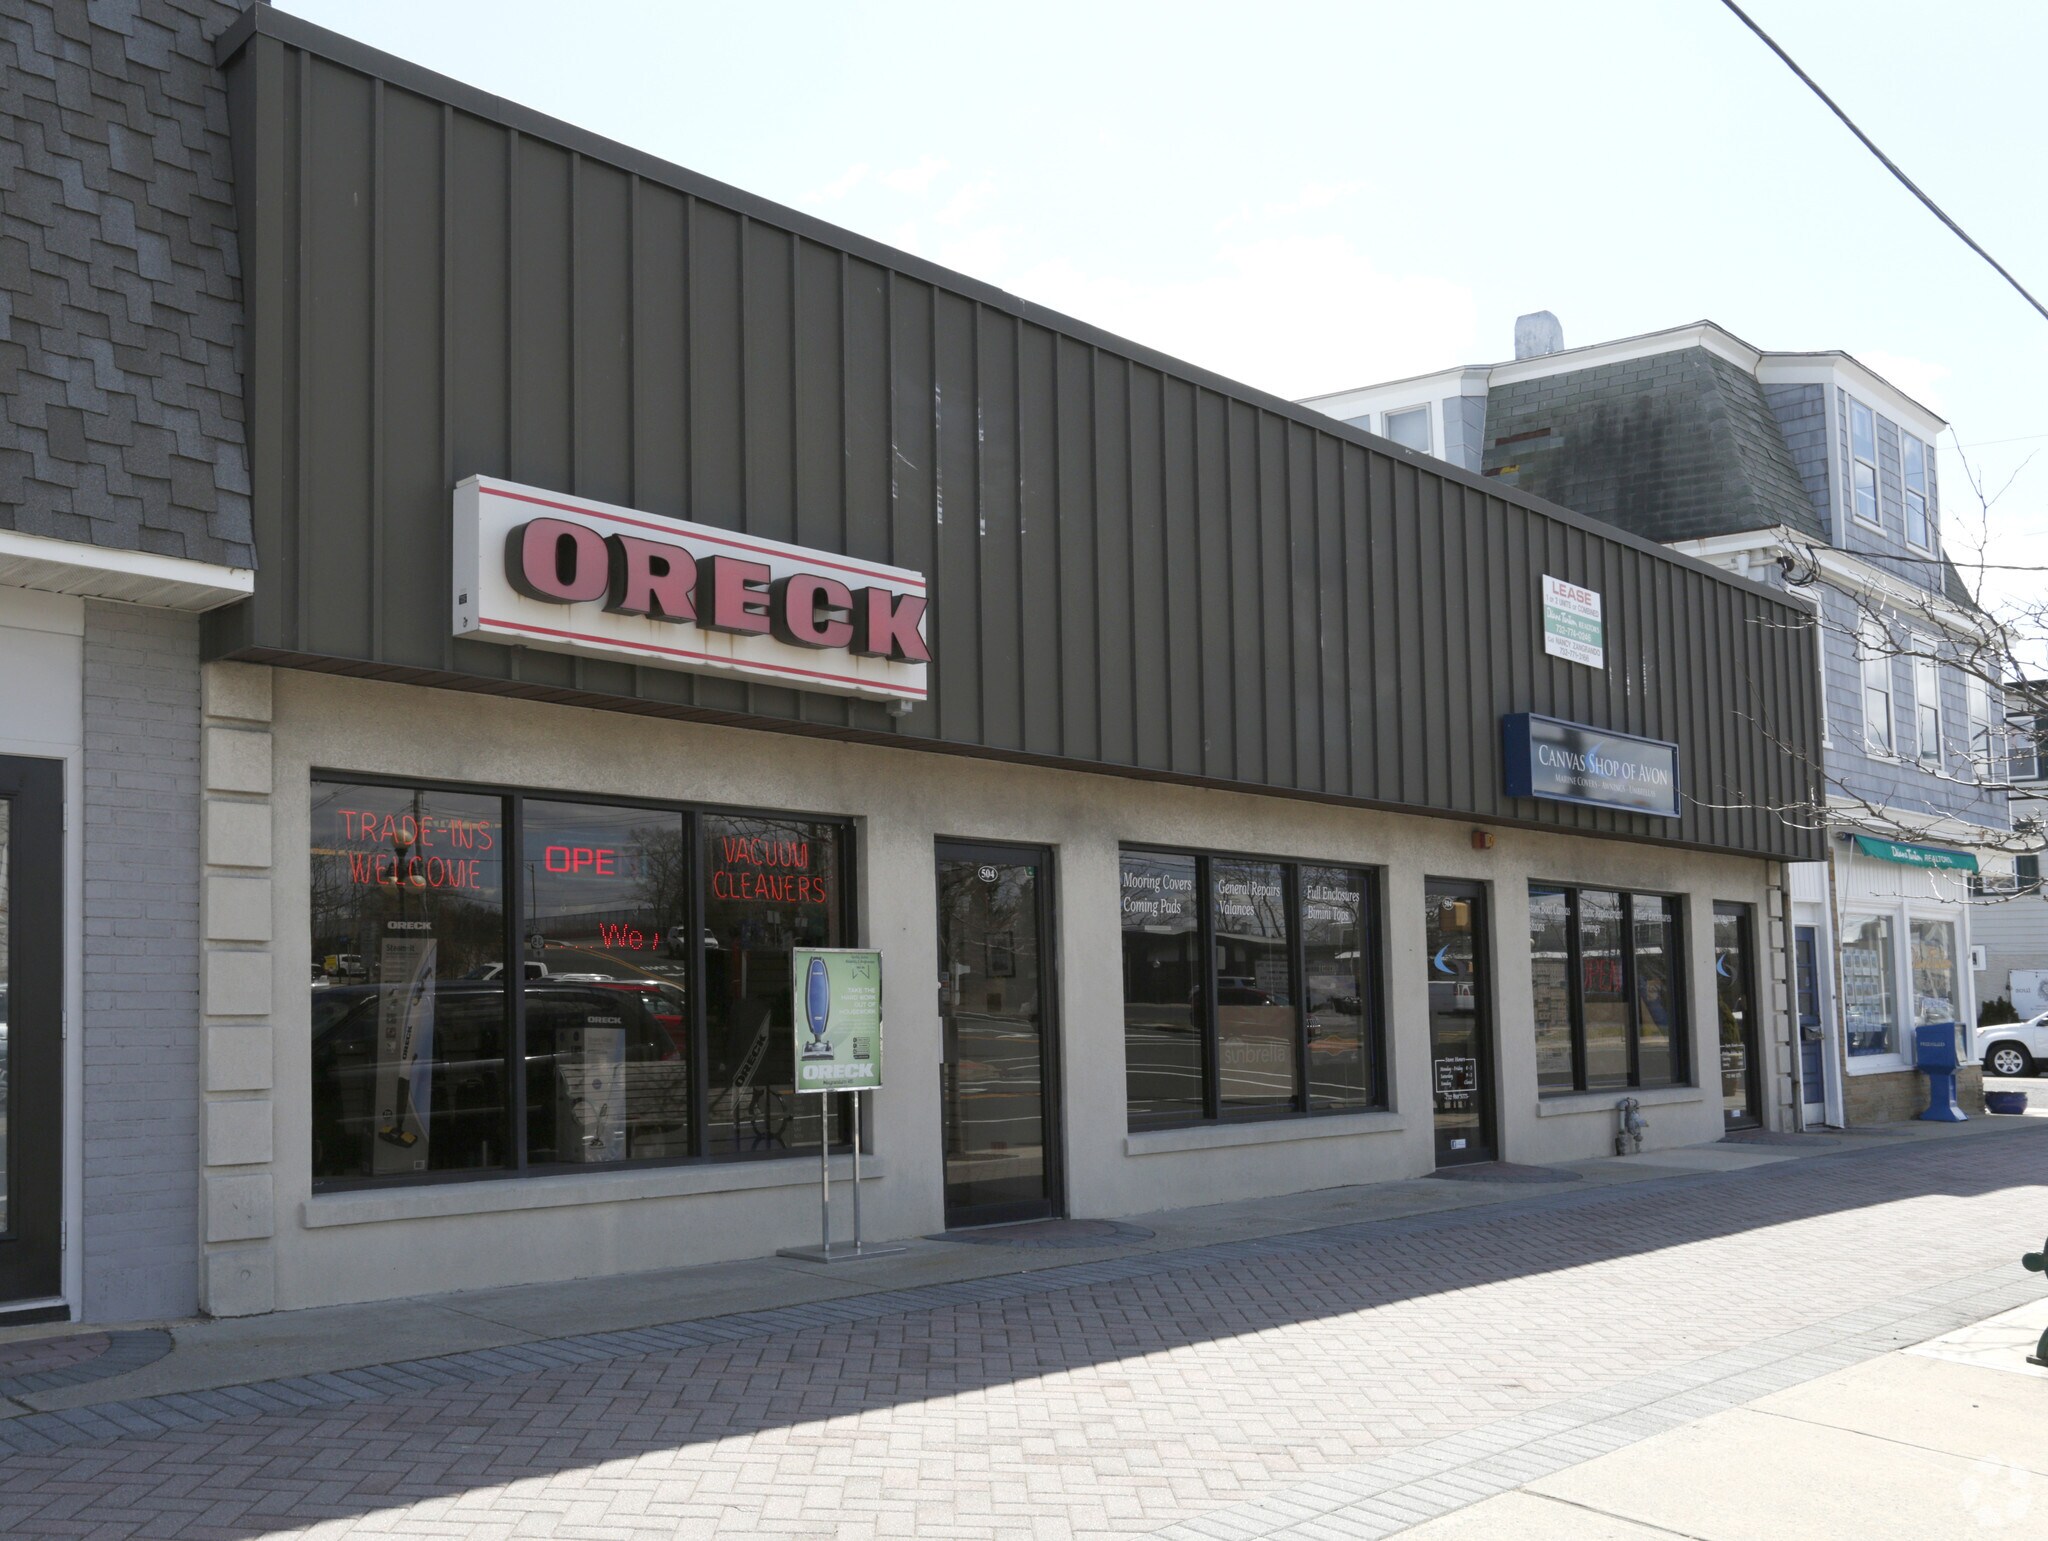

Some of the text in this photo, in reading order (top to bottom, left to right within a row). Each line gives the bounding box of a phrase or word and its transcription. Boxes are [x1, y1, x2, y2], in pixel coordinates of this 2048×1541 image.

[505, 517, 932, 664] ORECK
[1552, 581, 1592, 606] LEASE
[1538, 744, 1668, 785] CANVAS SHOP OF AVON
[337, 809, 494, 850] TRADE-INS
[722, 836, 808, 869] VACUUM
[350, 852, 481, 889] WELCOME
[981, 870, 995, 879] 504
[713, 871, 827, 903] CLEANERS
[1123, 872, 1192, 893] Mooring Covers
[1218, 879, 1281, 898] General Repairs
[1307, 885, 1360, 902] Full Enclosures
[1123, 897, 1181, 917] Coming Pads
[1219, 900, 1254, 916] Valances
[1308, 905, 1350, 921] Bimini Tops
[387, 921, 432, 930] ORECK
[587, 1016, 622, 1024] ORECK
[402, 1025, 412, 1060] ORECK
[1225, 1042, 1286, 1064] sunbrella
[735, 1034, 768, 1088] ORECK
[802, 1063, 875, 1080] ORECK
